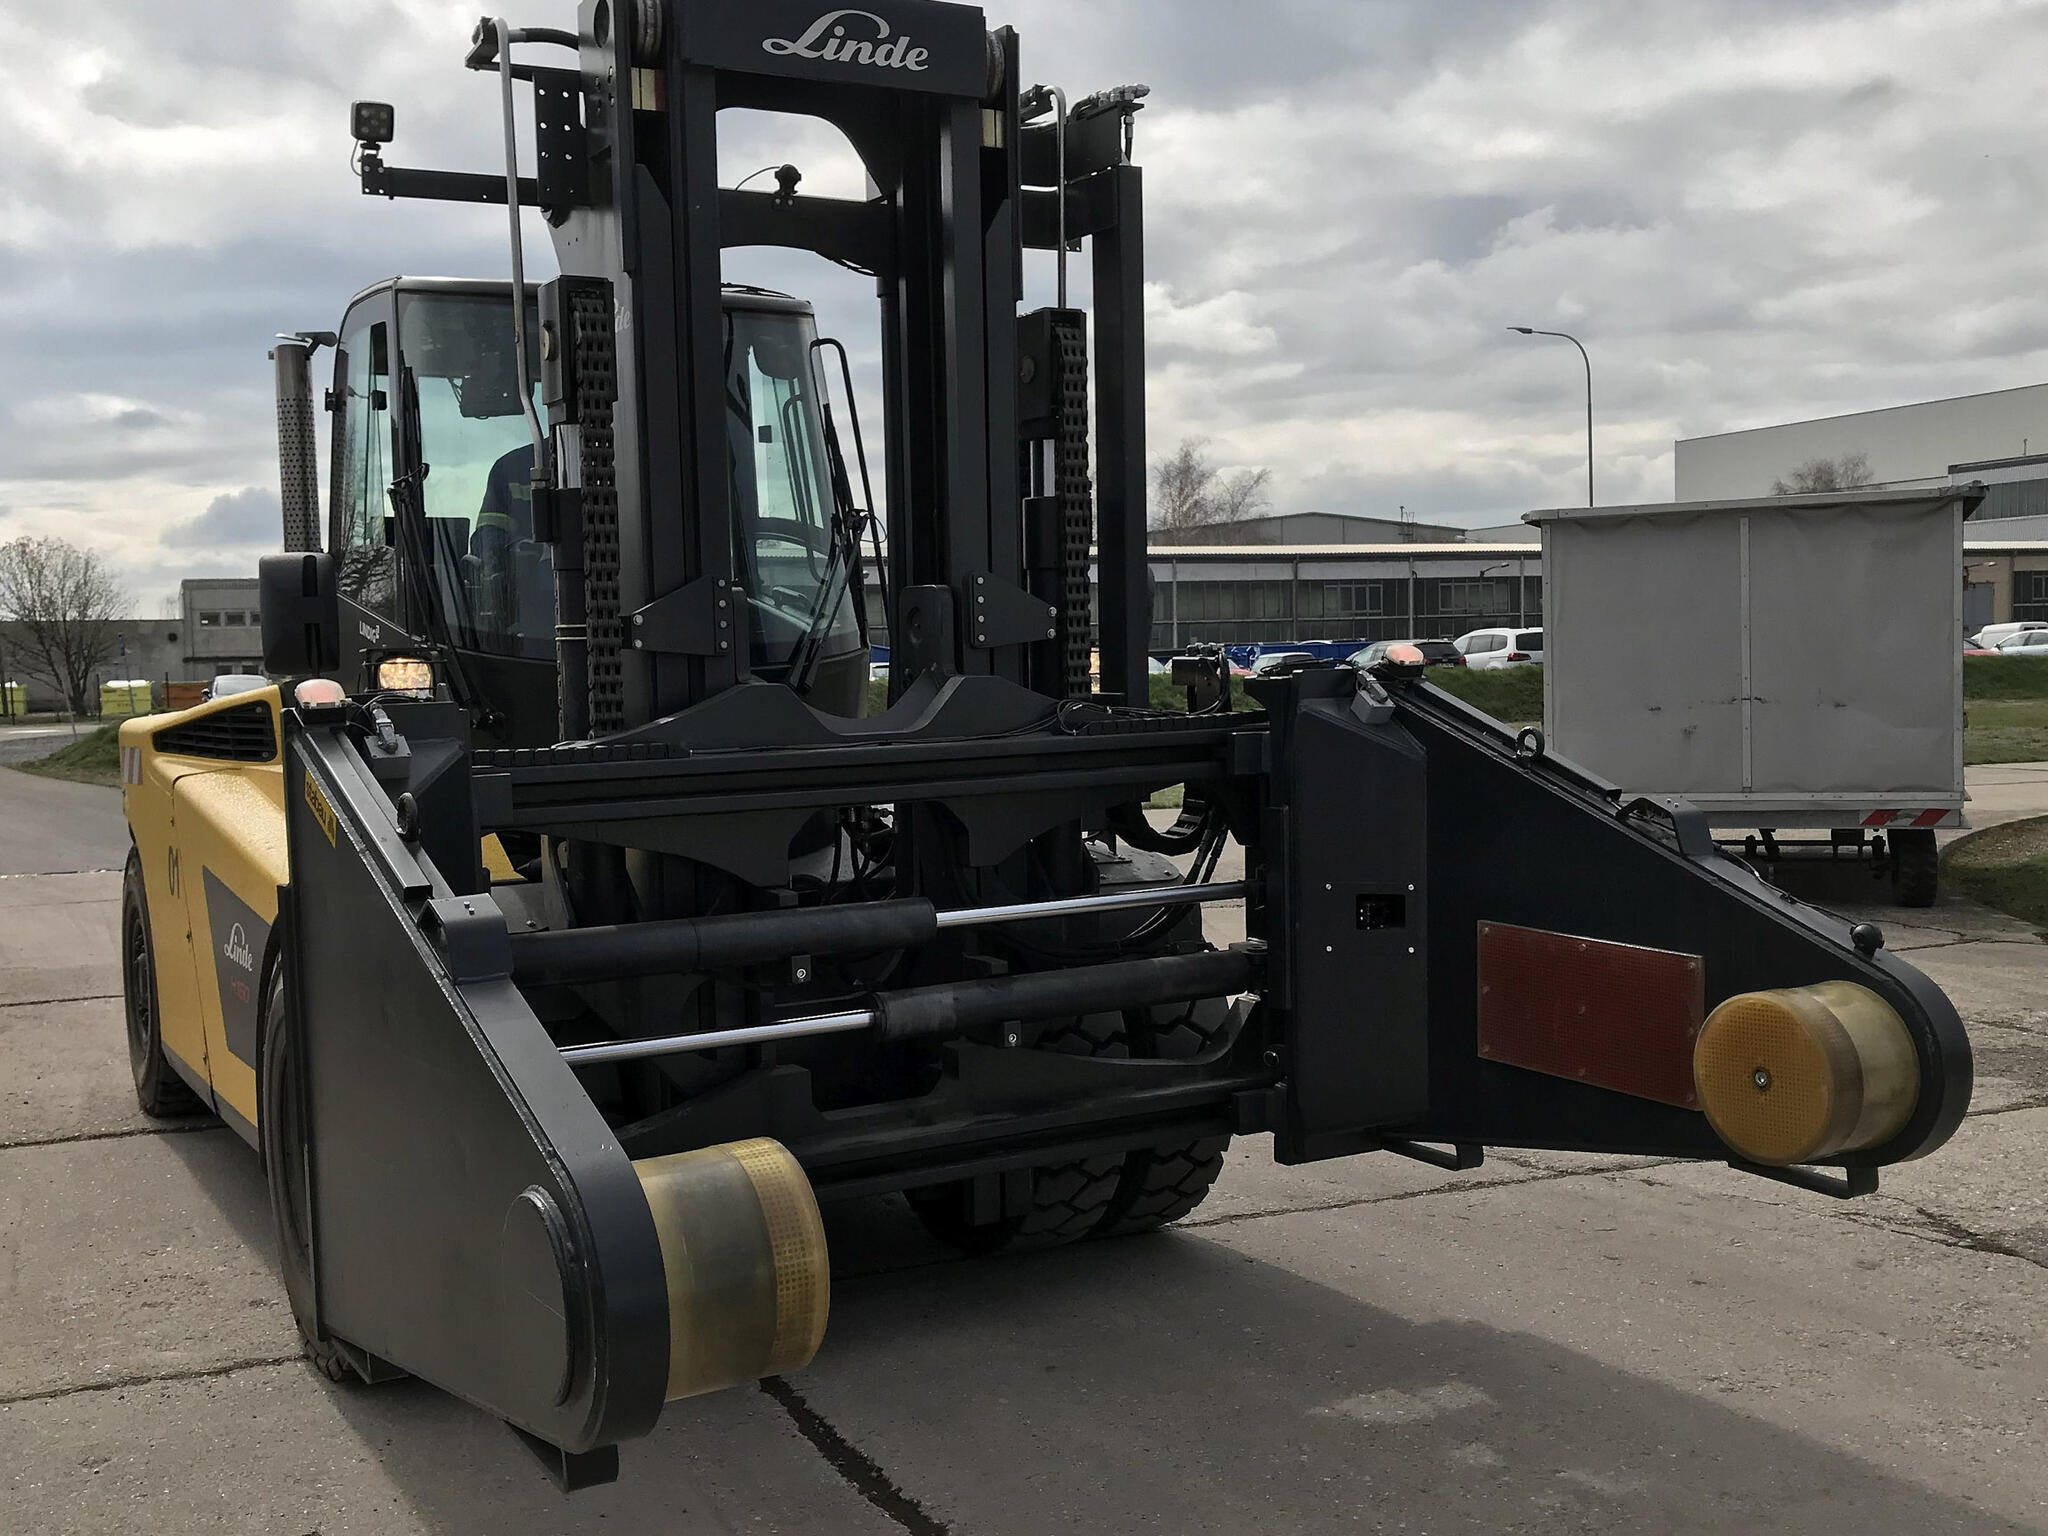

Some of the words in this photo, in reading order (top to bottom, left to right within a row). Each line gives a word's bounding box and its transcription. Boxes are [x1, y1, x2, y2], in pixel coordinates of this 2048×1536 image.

[762, 9, 929, 71] Linde
[168, 845, 180, 900] 01
[223, 922, 253, 973] Linde
